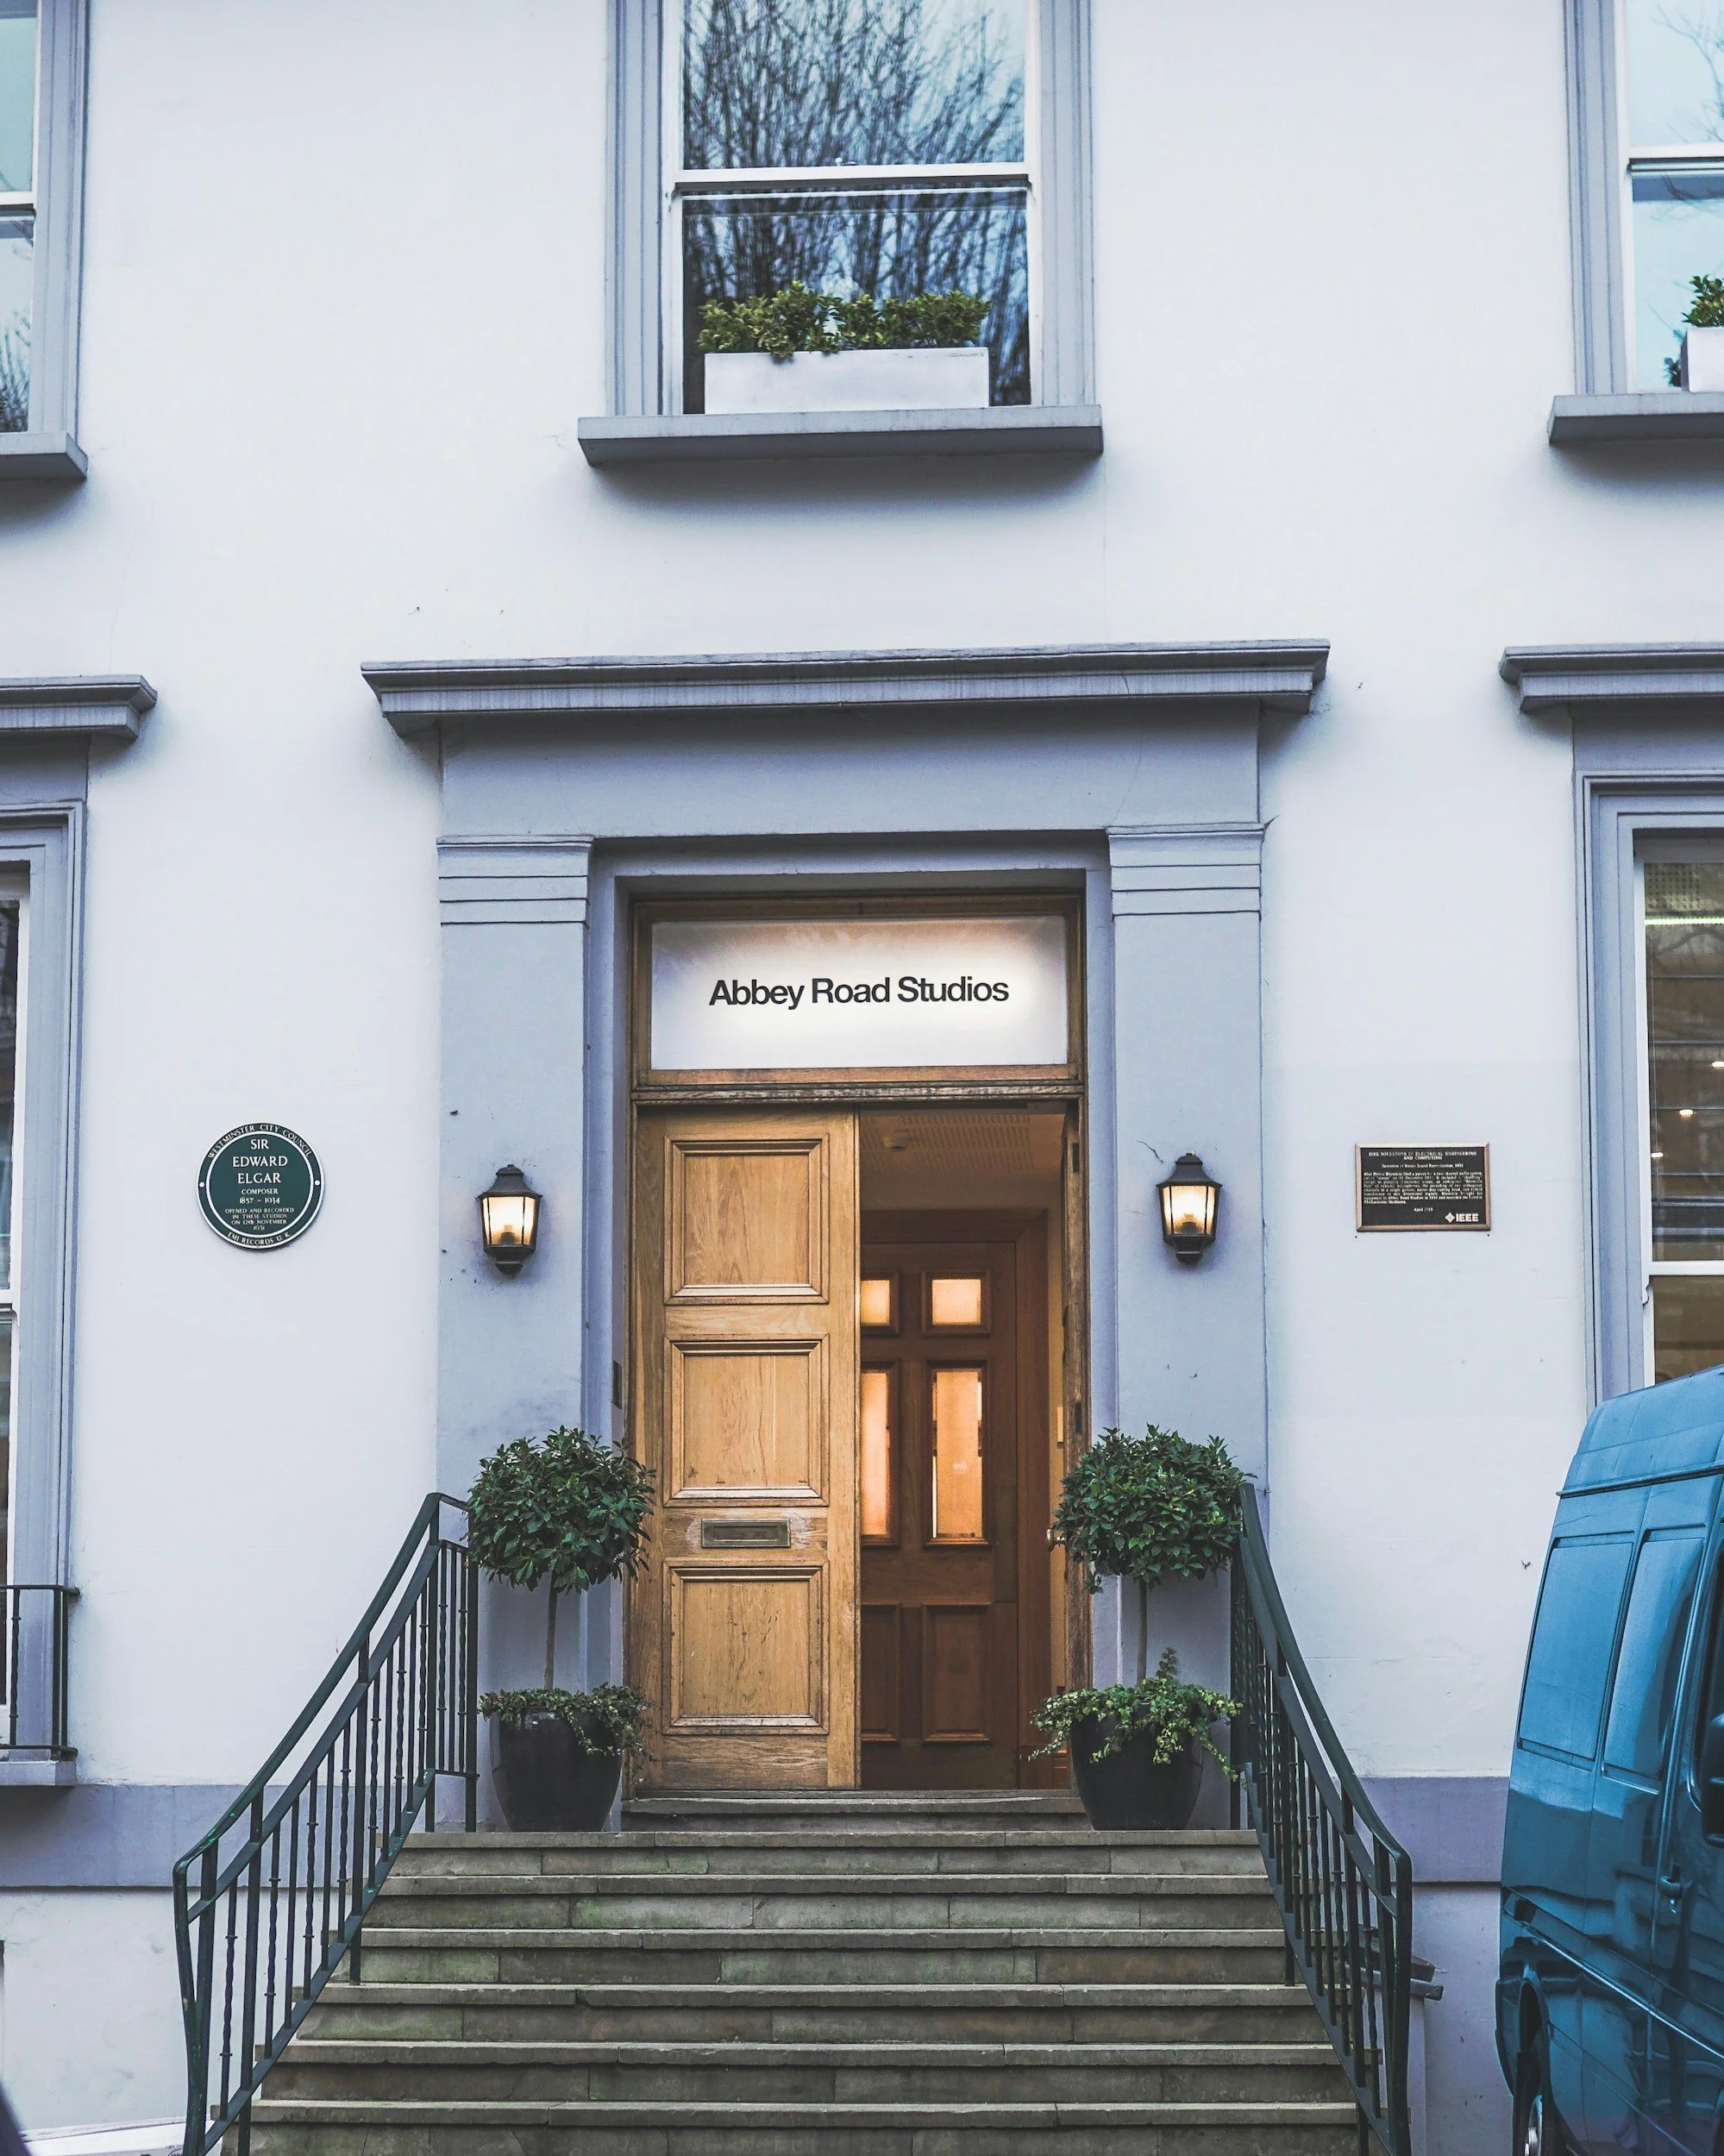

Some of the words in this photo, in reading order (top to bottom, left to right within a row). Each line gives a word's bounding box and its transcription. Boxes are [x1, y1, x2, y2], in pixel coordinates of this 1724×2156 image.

[709, 980, 805, 1010] Abbey
[812, 977, 890, 1003] Road
[898, 976, 1009, 1002] Studios
[207, 1125, 255, 1158] WESTMINSTER
[260, 1124, 280, 1132] CITY
[282, 1130, 312, 1157] COUNCIL
[250, 1138, 269, 1150] SIR
[232, 1156, 288, 1167] EDWARD
[237, 1173, 281, 1184] ELGAR
[1456, 1213, 1479, 1222] IEEE
[228, 1232, 240, 1241] EMI
